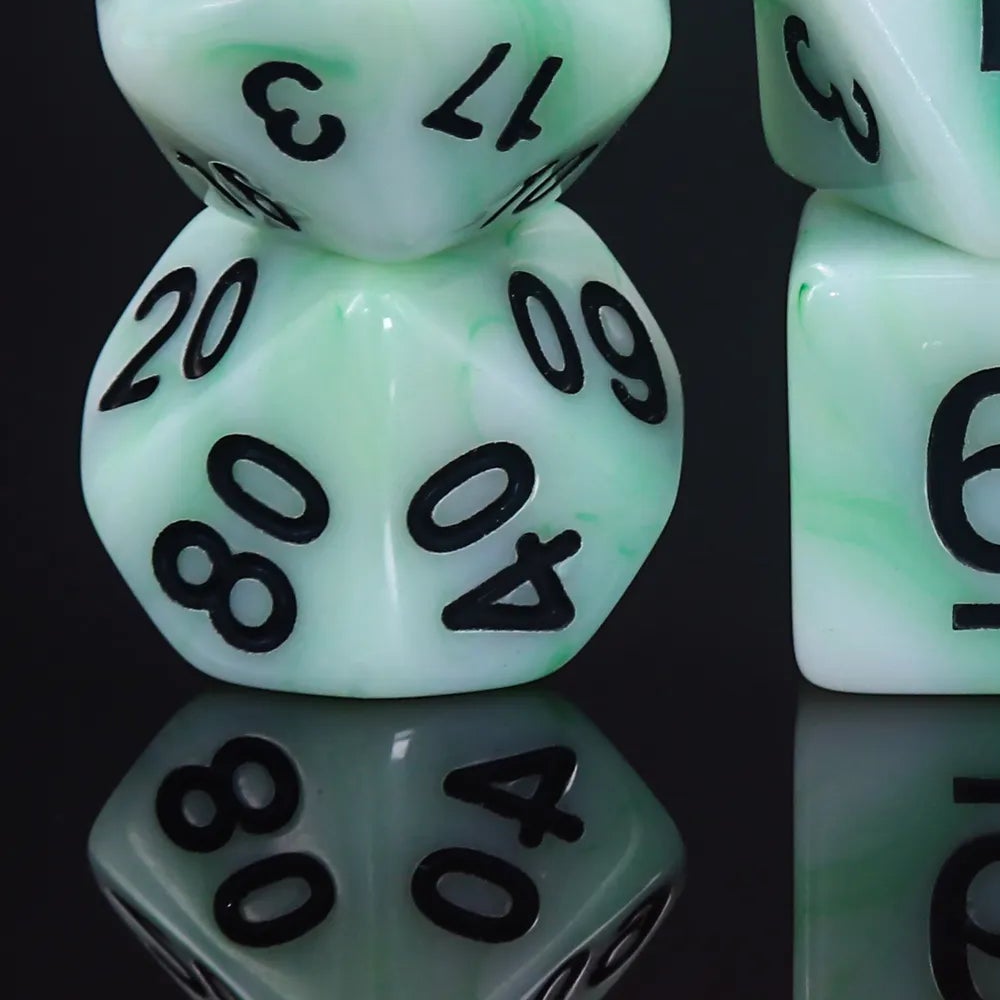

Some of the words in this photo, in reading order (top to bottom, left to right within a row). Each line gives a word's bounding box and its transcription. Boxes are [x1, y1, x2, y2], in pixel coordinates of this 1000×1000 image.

[241, 60, 347, 162] 3
[421, 43, 563, 152] 17
[783, 15, 880, 163] 3
[99, 256, 260, 412] 20
[152, 434, 330, 654] 80
[406, 442, 581, 632] 40
